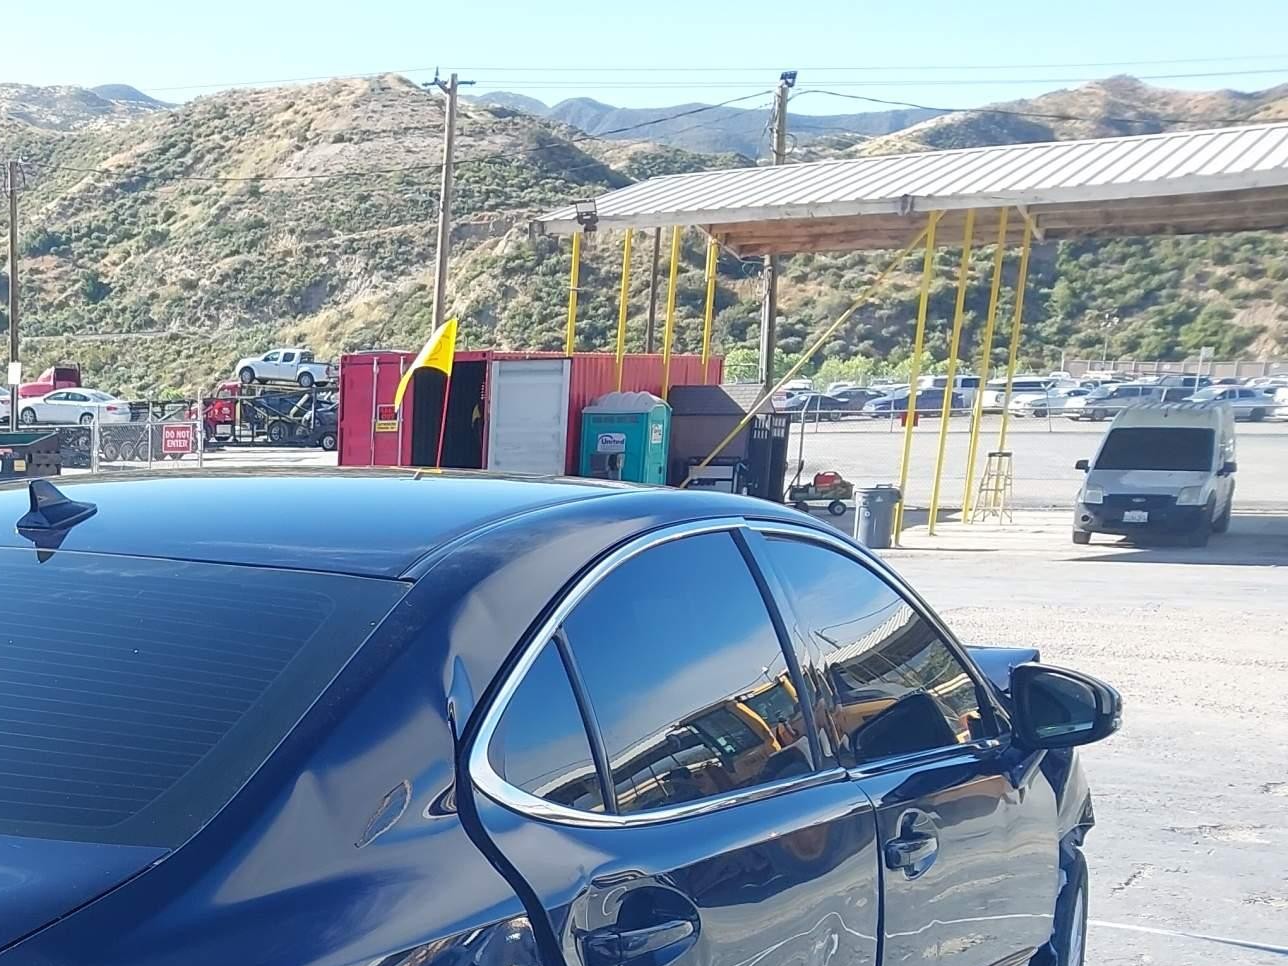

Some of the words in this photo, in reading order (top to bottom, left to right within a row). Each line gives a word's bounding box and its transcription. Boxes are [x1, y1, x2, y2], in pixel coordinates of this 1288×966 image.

[165, 430, 175, 439] DO
[176, 430, 190, 439] NOT
[167, 440, 188, 448] ENTER
